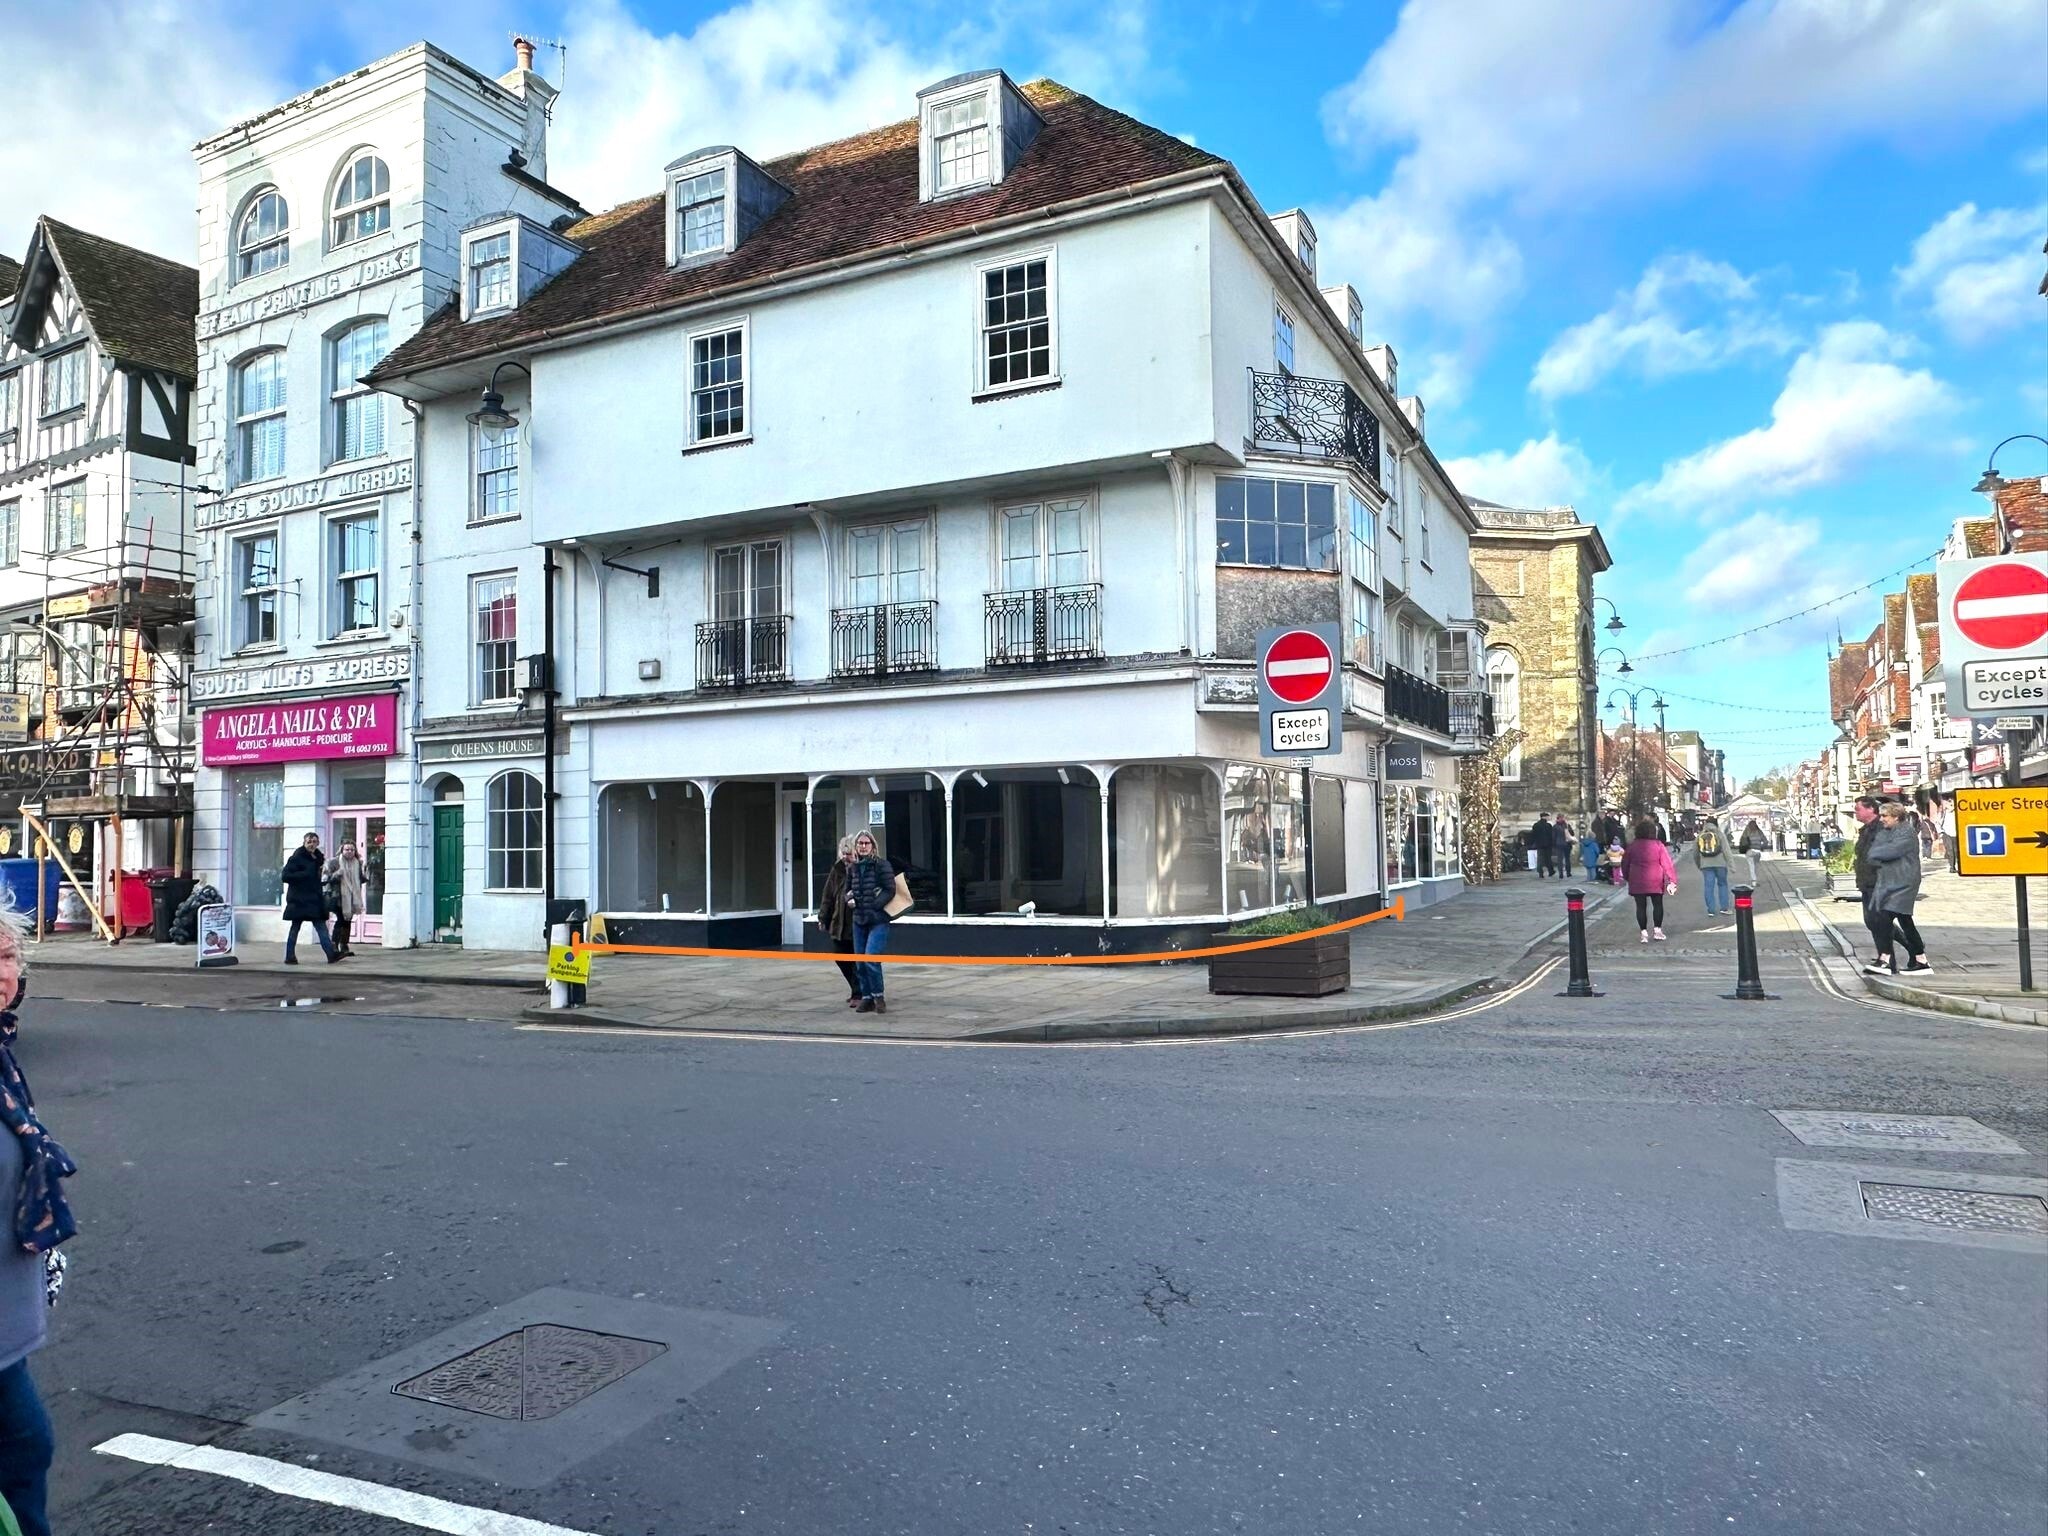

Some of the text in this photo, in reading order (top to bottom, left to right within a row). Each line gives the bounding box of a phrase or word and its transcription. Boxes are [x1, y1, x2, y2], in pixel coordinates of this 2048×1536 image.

[200, 301, 256, 334] STEAM
[261, 275, 340, 317] PRINTING
[256, 480, 327, 514] COUNTY
[338, 463, 412, 496] MIRROR
[195, 654, 409, 695] SOUTH WILTS EXPRESS
[1975, 666, 2047, 683] Except
[1978, 685, 2044, 703] cycles
[216, 703, 376, 739] ANGELA NAILS & SPA
[1278, 715, 1322, 730] Except
[236, 739, 267, 751] ACRYLICS
[272, 736, 312, 748] MANICURE
[316, 733, 352, 745] PEDICURE
[1280, 731, 1321, 745] cycles
[451, 739, 534, 756] QUEENS HOUSE
[1389, 757, 1418, 767] MOSS
[1958, 798, 2005, 811] Culver
[1975, 828, 1995, 854] P
[557, 962, 580, 973] Parking
